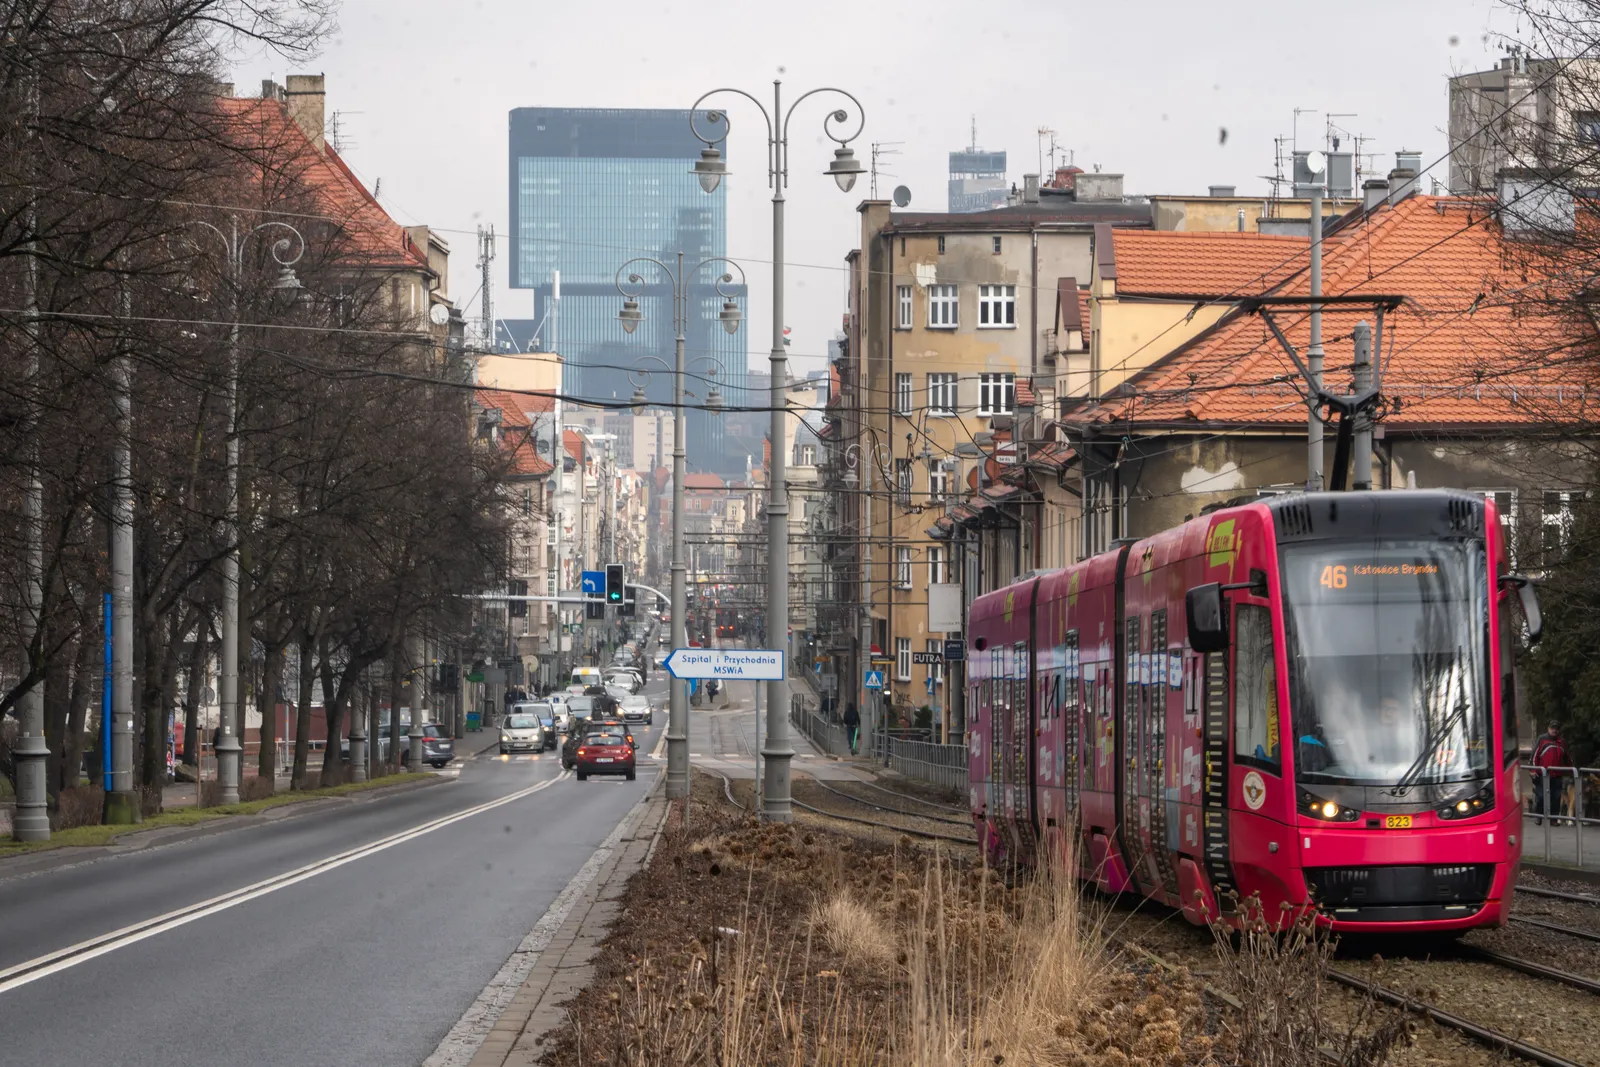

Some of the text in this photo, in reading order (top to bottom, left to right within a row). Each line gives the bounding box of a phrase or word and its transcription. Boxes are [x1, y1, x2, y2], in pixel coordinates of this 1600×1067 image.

[951, 193, 989, 208] COURTYARD
[1319, 564, 1348, 589] 46
[1353, 564, 1399, 575] Katowice
[682, 655, 776, 665] Szpital i Przychodnia
[913, 653, 942, 663] FUTRA
[713, 666, 743, 674] MSWiA
[1387, 816, 1410, 828] 823
